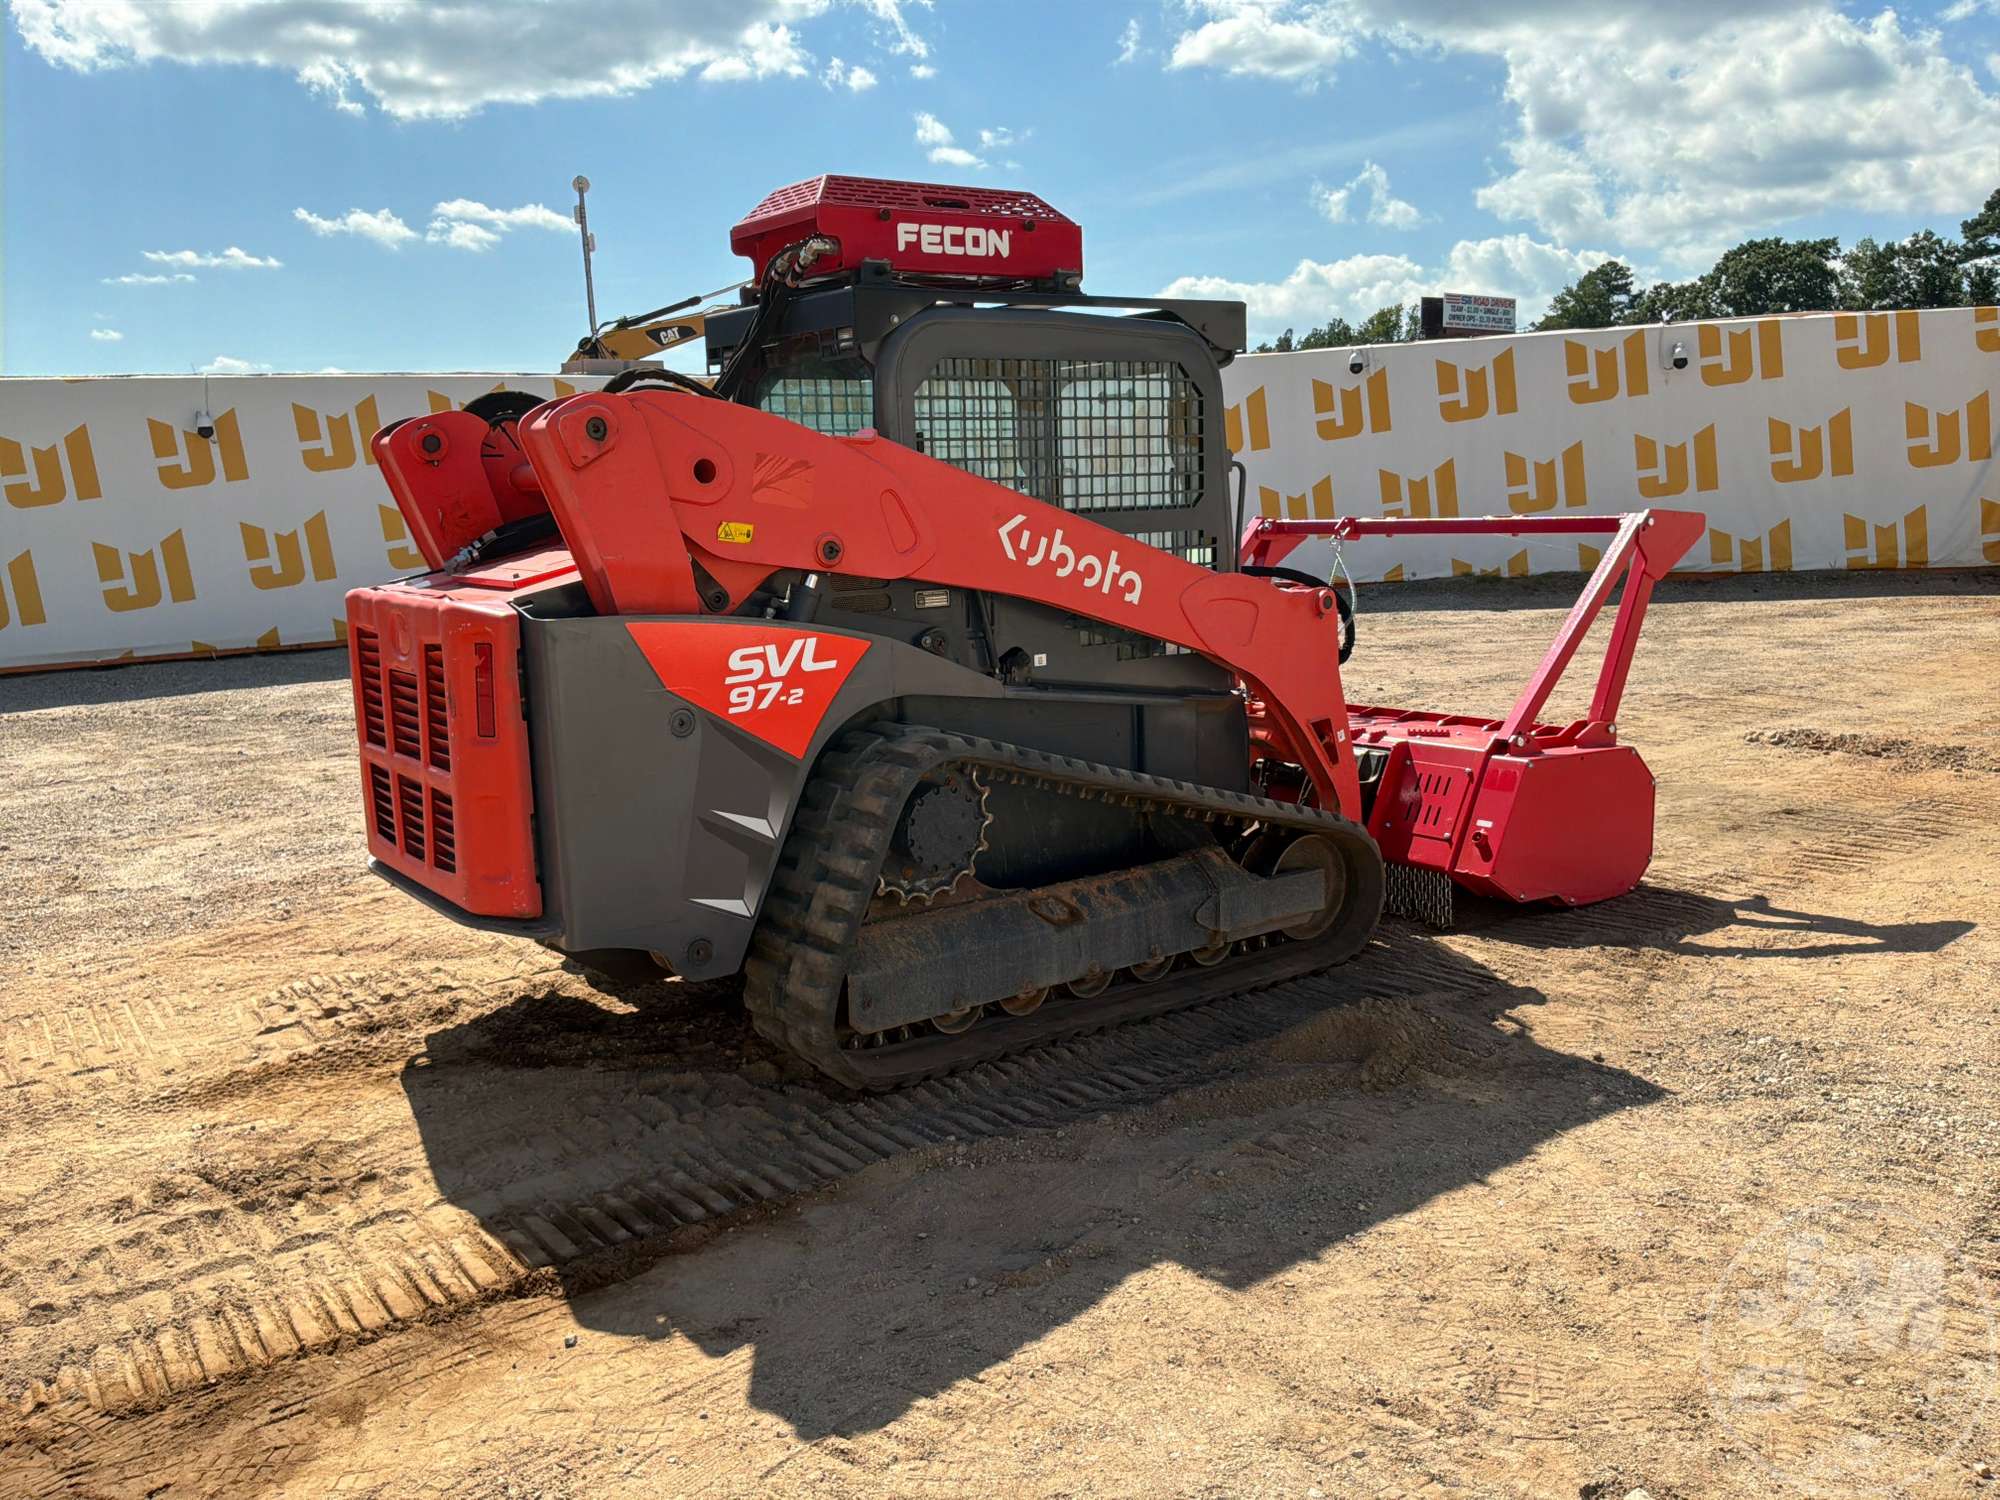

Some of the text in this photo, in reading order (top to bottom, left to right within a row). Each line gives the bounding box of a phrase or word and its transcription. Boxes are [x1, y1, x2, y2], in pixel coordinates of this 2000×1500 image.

[897, 222, 1011, 258] FECON
[660, 327, 680, 345] CAT
[998, 514, 1143, 605] Kubota
[725, 637, 837, 684] SVL
[728, 681, 804, 714] 97-2
